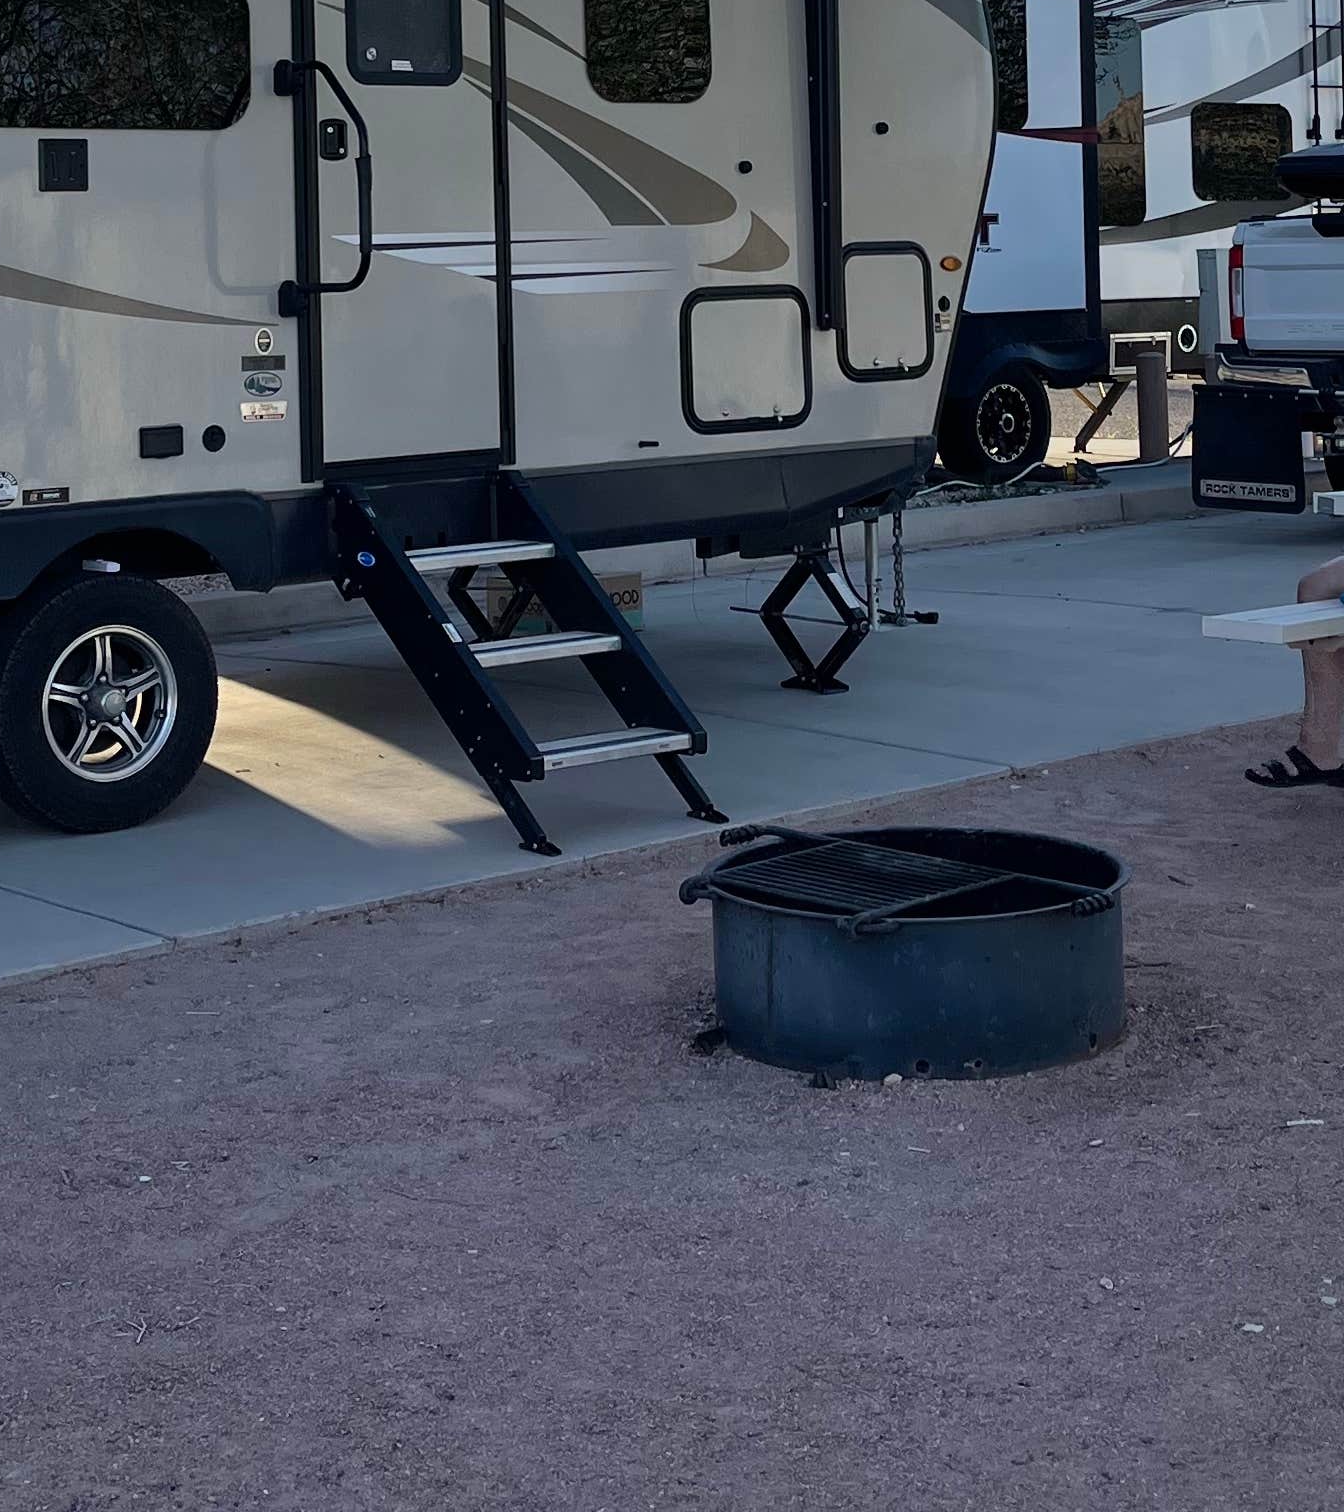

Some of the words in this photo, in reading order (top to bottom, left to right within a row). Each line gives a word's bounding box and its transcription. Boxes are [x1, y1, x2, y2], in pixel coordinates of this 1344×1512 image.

[1205, 483, 1236, 494] ROCK
[1239, 485, 1290, 498] TAMERS
[609, 589, 640, 607] OOD
